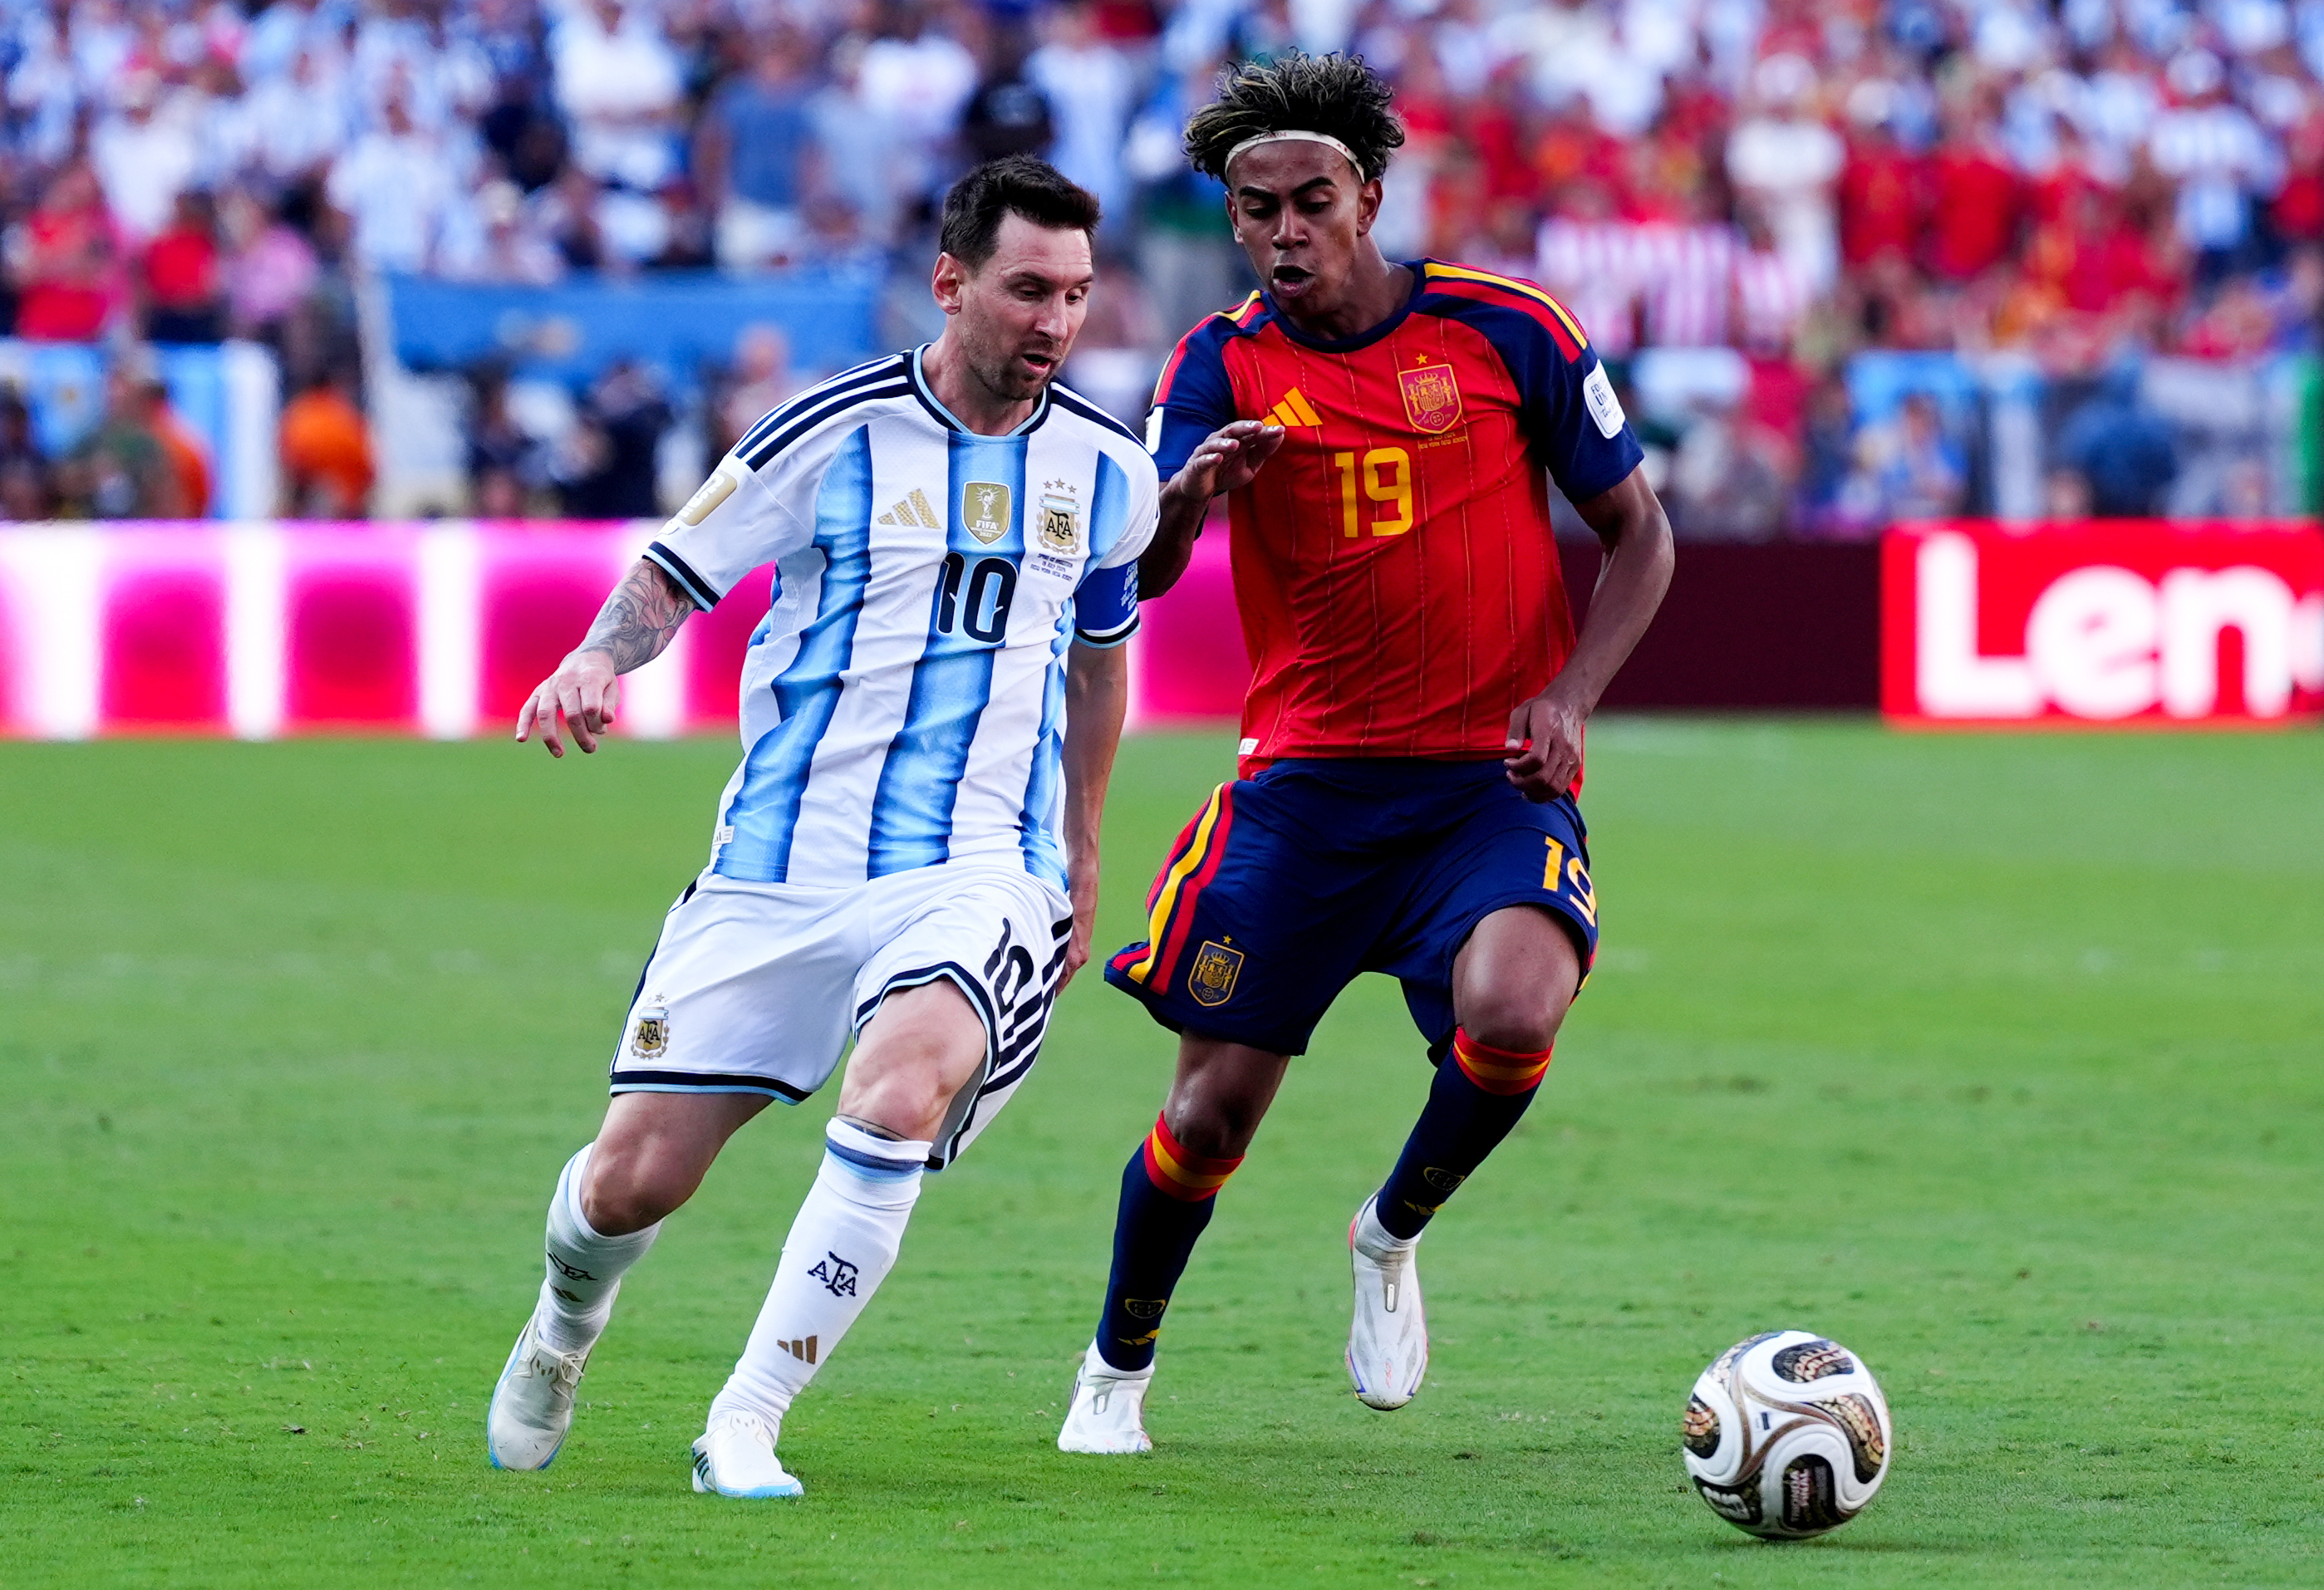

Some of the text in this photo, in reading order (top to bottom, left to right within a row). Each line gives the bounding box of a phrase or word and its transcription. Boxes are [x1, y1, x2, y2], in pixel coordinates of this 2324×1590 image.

[975, 520, 998, 531] FIFA
[1045, 510, 1073, 540] AFA
[1334, 447, 1413, 537] 19
[936, 552, 1019, 645] 10
[1542, 836, 1597, 928] 19
[984, 917, 1034, 1008] 10
[807, 1250, 859, 1297] AFA
